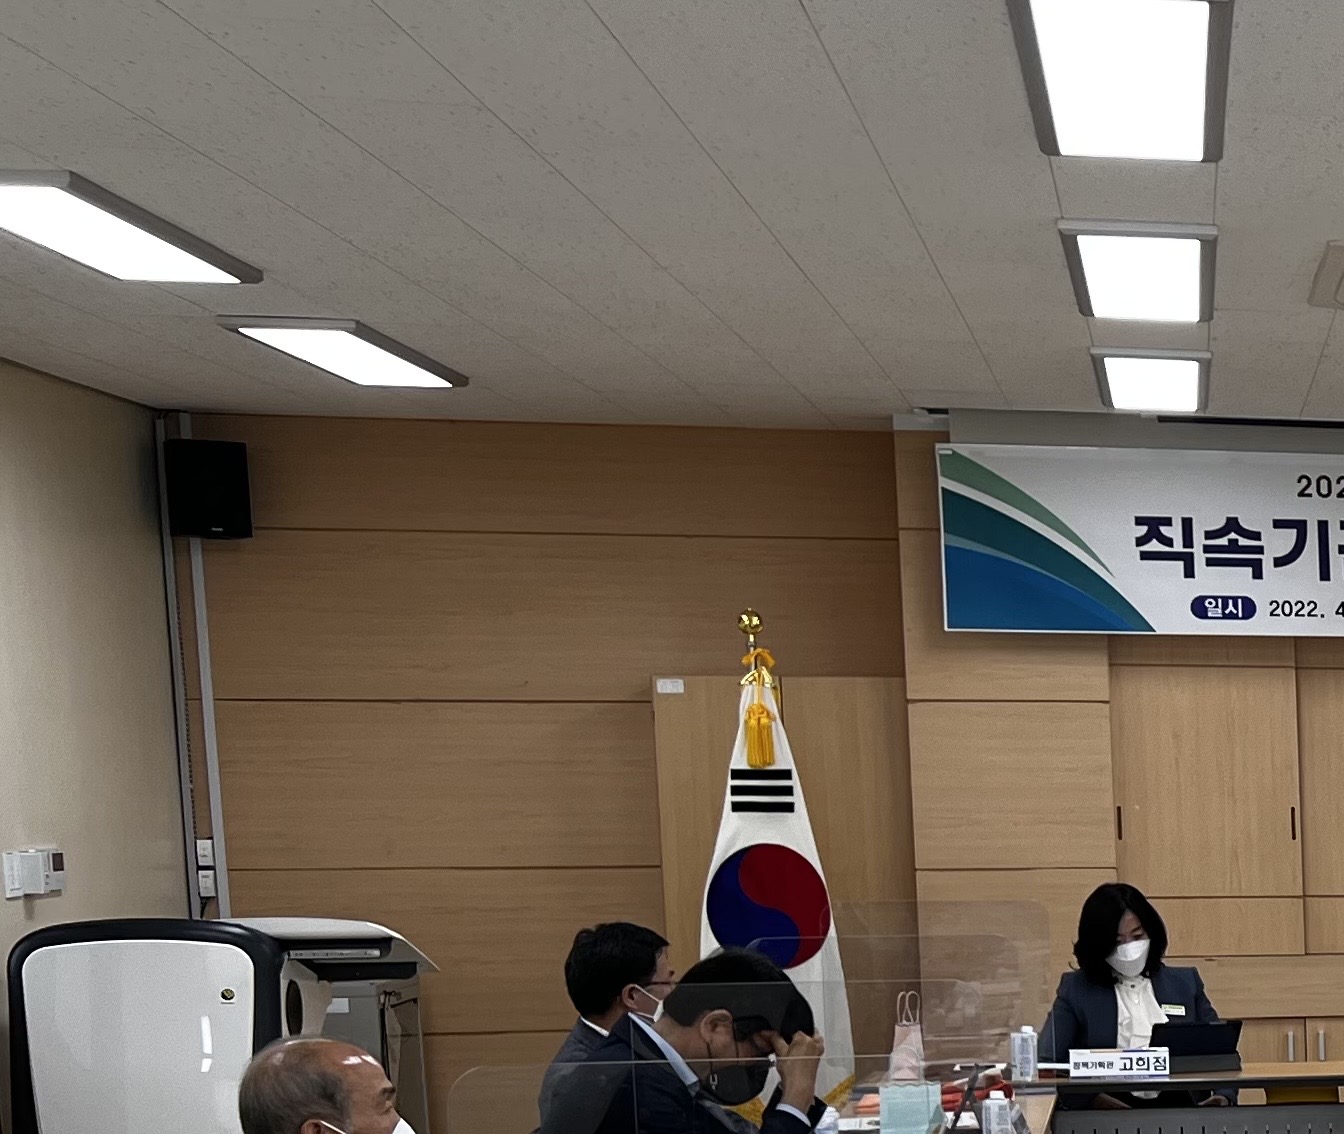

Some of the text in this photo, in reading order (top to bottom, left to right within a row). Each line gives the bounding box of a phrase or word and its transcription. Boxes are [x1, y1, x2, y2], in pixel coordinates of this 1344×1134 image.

[1203, 598, 1244, 618] 일시
[1268, 600, 1325, 618] 2022.
[1119, 1056, 1167, 1071] 고희점
